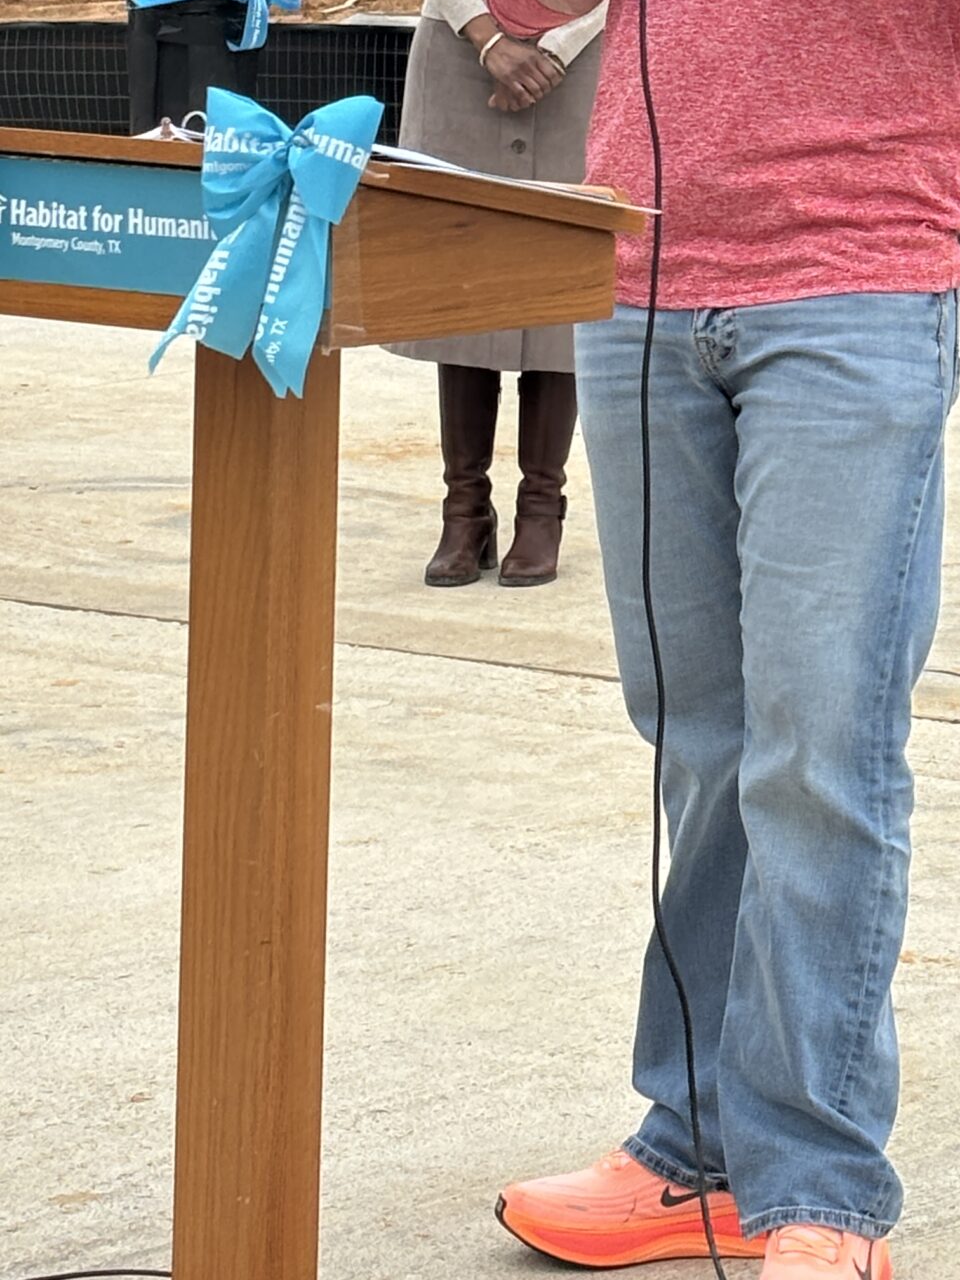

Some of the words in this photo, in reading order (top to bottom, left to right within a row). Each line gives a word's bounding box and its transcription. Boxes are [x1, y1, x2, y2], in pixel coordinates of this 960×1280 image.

[10, 198, 88, 231] Habitat
[92, 204, 124, 234] for
[11, 232, 69, 253] Montgomery
[107, 239, 122, 255] TX
